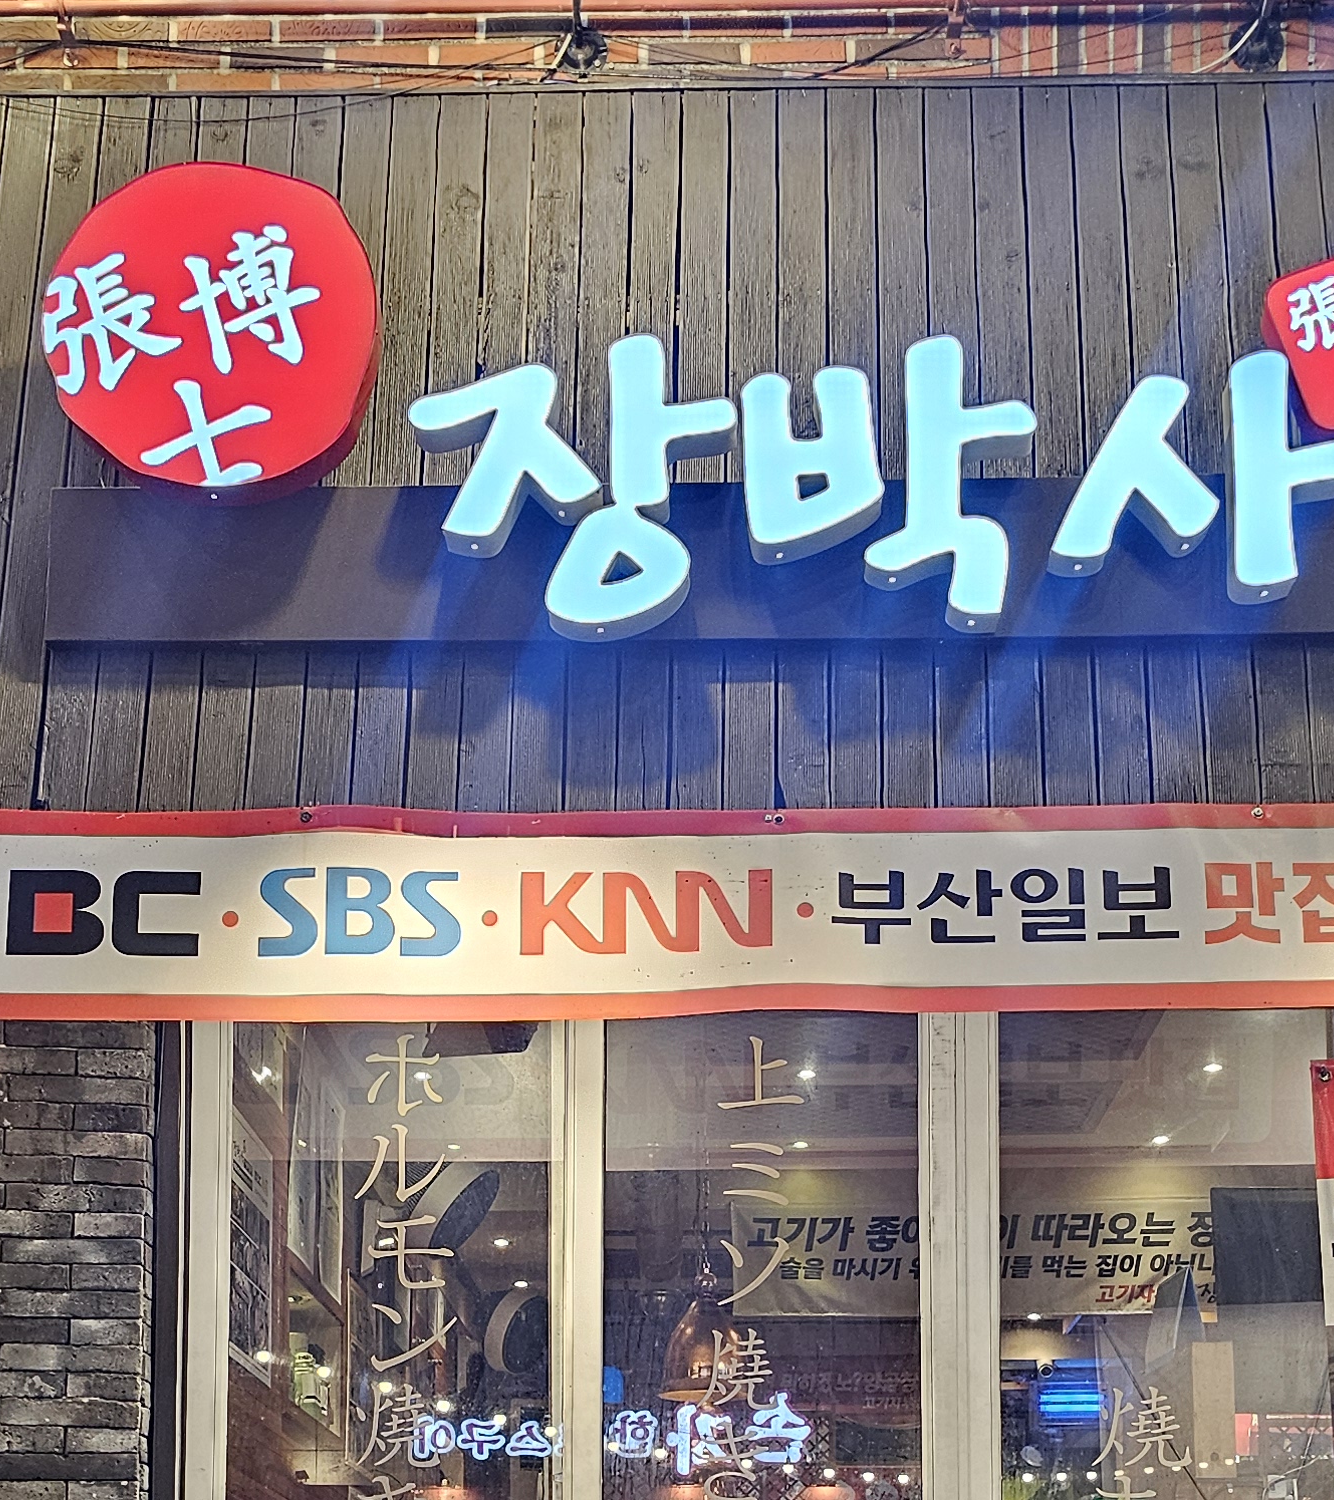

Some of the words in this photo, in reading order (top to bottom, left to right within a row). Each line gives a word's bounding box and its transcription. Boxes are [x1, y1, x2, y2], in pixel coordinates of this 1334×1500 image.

[258, 866, 461, 957] SBS
[519, 868, 774, 955] KNN
[831, 865, 1180, 946] 부산일보
[747, 1216, 856, 1253] 고기가
[1030, 1211, 1176, 1249] 따라오는
[779, 1256, 825, 1281] 술을
[831, 1257, 904, 1281] 마시기
[1042, 1254, 1089, 1279] 먹는
[1095, 1253, 1143, 1279] 집이
